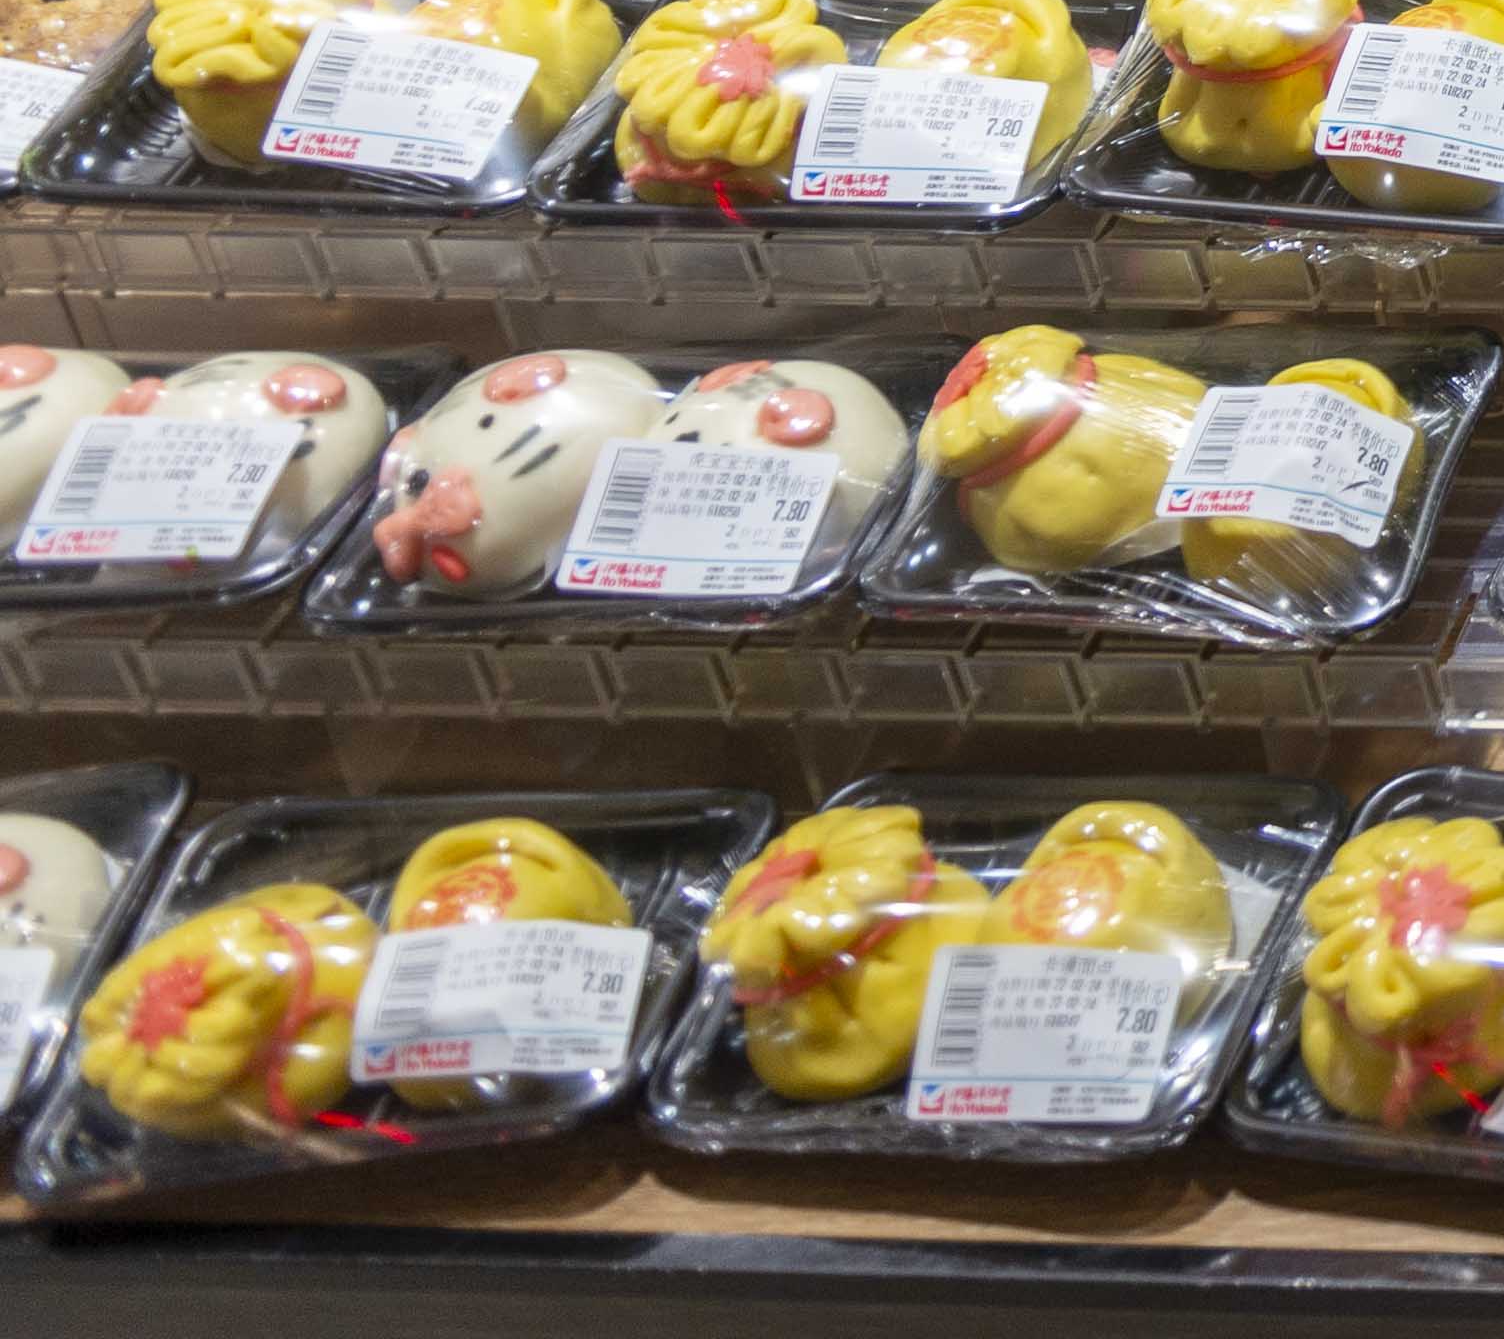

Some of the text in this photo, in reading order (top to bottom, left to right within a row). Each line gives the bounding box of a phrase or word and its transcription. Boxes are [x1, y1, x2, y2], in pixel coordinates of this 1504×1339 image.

[985, 117, 1023, 138] 7.80
[1369, 144, 1402, 157] Yokado
[849, 187, 887, 198] Yokado
[1356, 446, 1390, 477] 7.80
[772, 499, 811, 522] 7.80
[617, 578, 662, 589] Yokado
[582, 972, 623, 994] 7.80
[1116, 1008, 1158, 1033] 7.80
